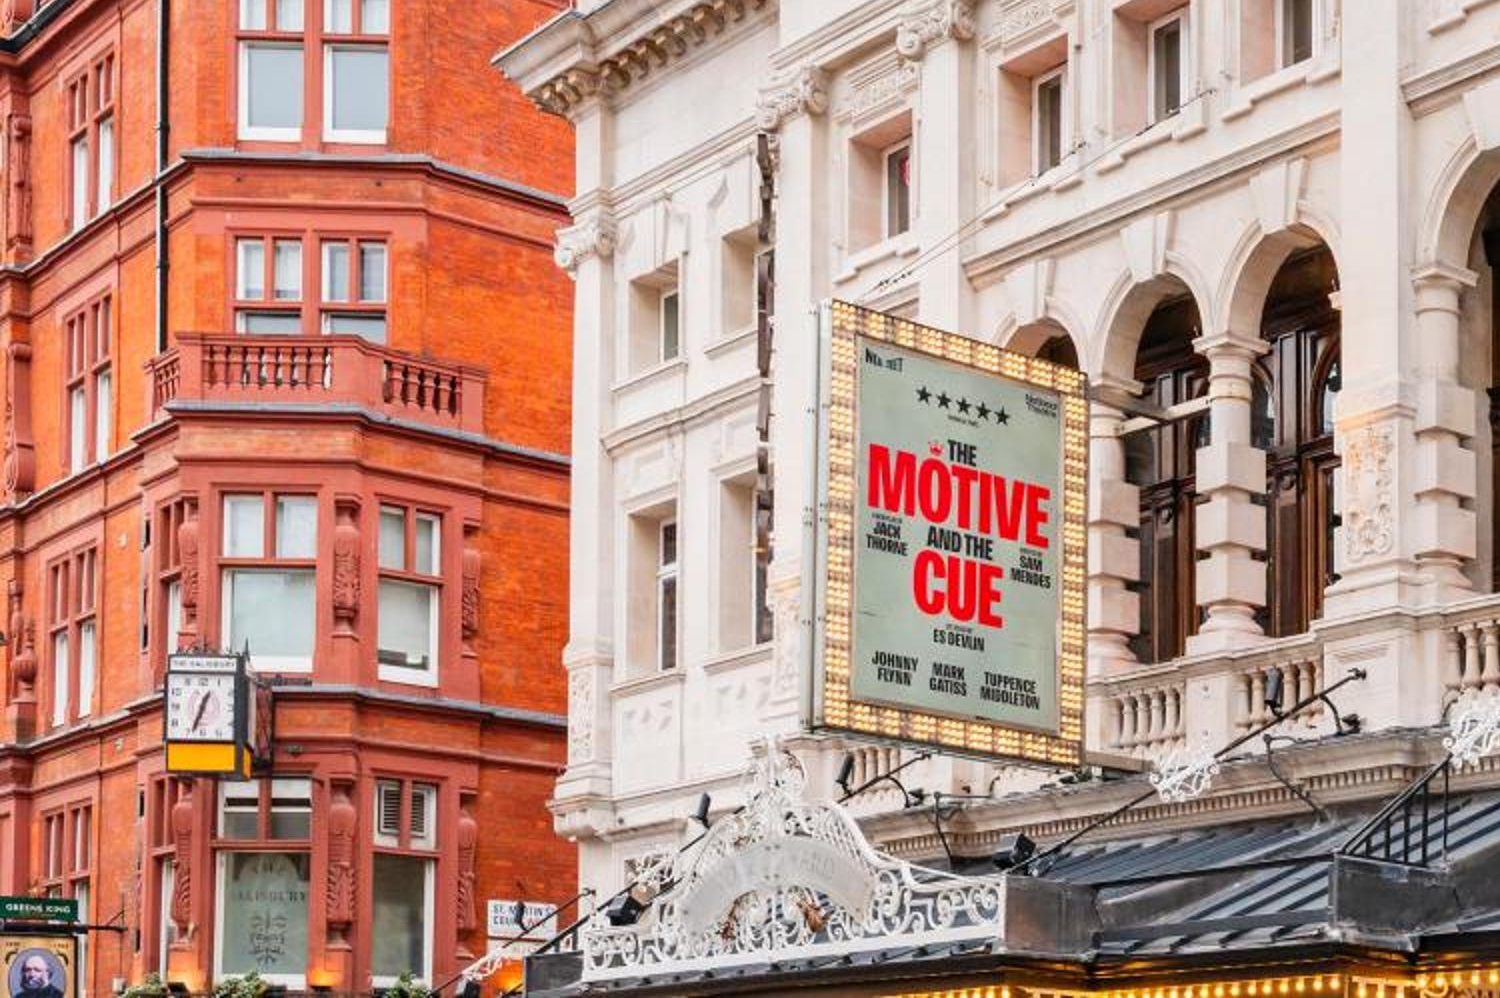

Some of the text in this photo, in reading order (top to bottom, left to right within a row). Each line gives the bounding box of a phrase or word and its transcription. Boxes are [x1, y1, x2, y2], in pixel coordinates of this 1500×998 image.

[948, 439, 977, 467] THE
[867, 443, 1051, 549] MOTIVE
[873, 521, 901, 539] JACK
[866, 534, 908, 556] THORNE
[927, 525, 993, 561] AND THE
[1019, 556, 1043, 572] SAM
[914, 549, 1004, 629] CUE
[1010, 567, 1051, 589] MENDES
[933, 629, 985, 652] ES DEVLIN
[872, 650, 918, 672] JOHNNY
[932, 662, 965, 681] MARK
[877, 668, 912, 686] FLYNN
[929, 676, 967, 697] GATISS
[984, 671, 1037, 694] TUPPENCE
[980, 686, 1040, 710] MIDDLETON
